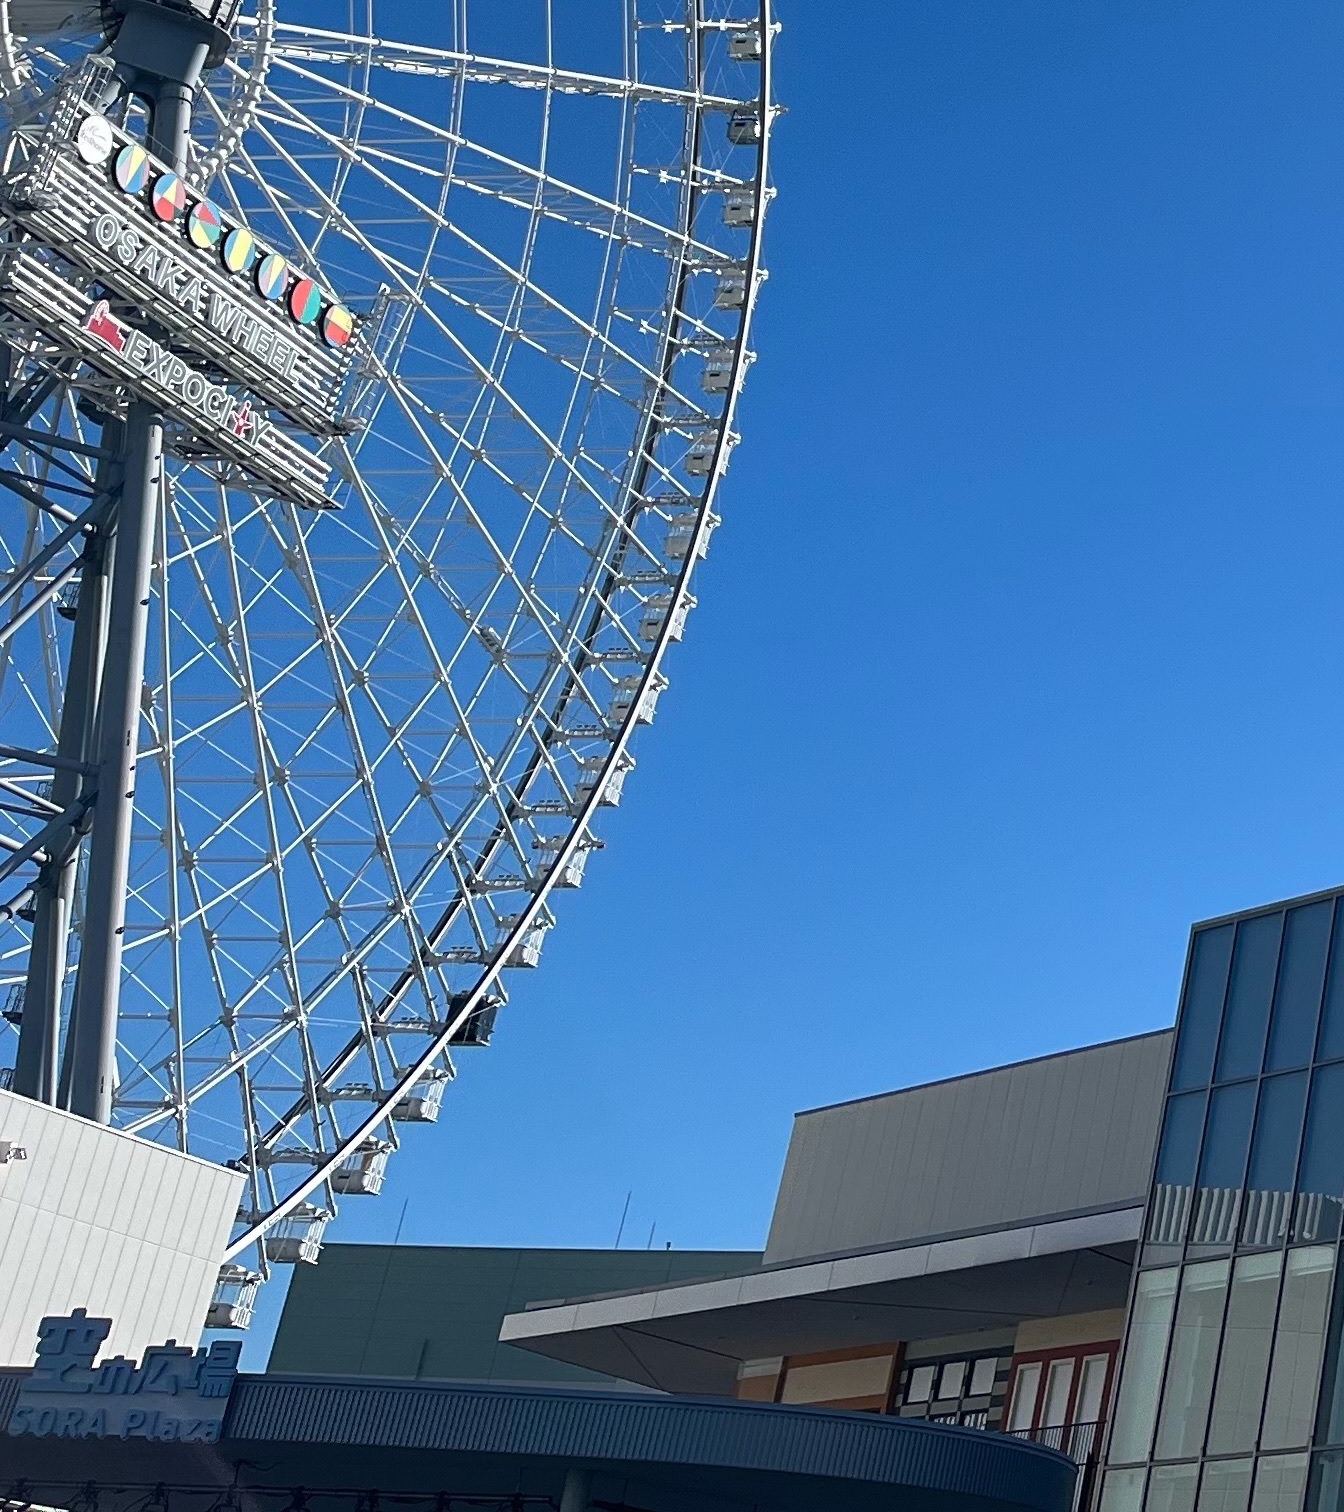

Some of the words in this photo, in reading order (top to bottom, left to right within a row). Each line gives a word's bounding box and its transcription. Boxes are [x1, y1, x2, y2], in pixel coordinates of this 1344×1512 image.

[95, 213, 203, 310] OSAKA
[208, 291, 303, 383] WHEEL
[22, 1307, 243, 1398] 空の広場
[8, 1406, 110, 1439] SORA
[121, 1409, 222, 1443] Plaza
